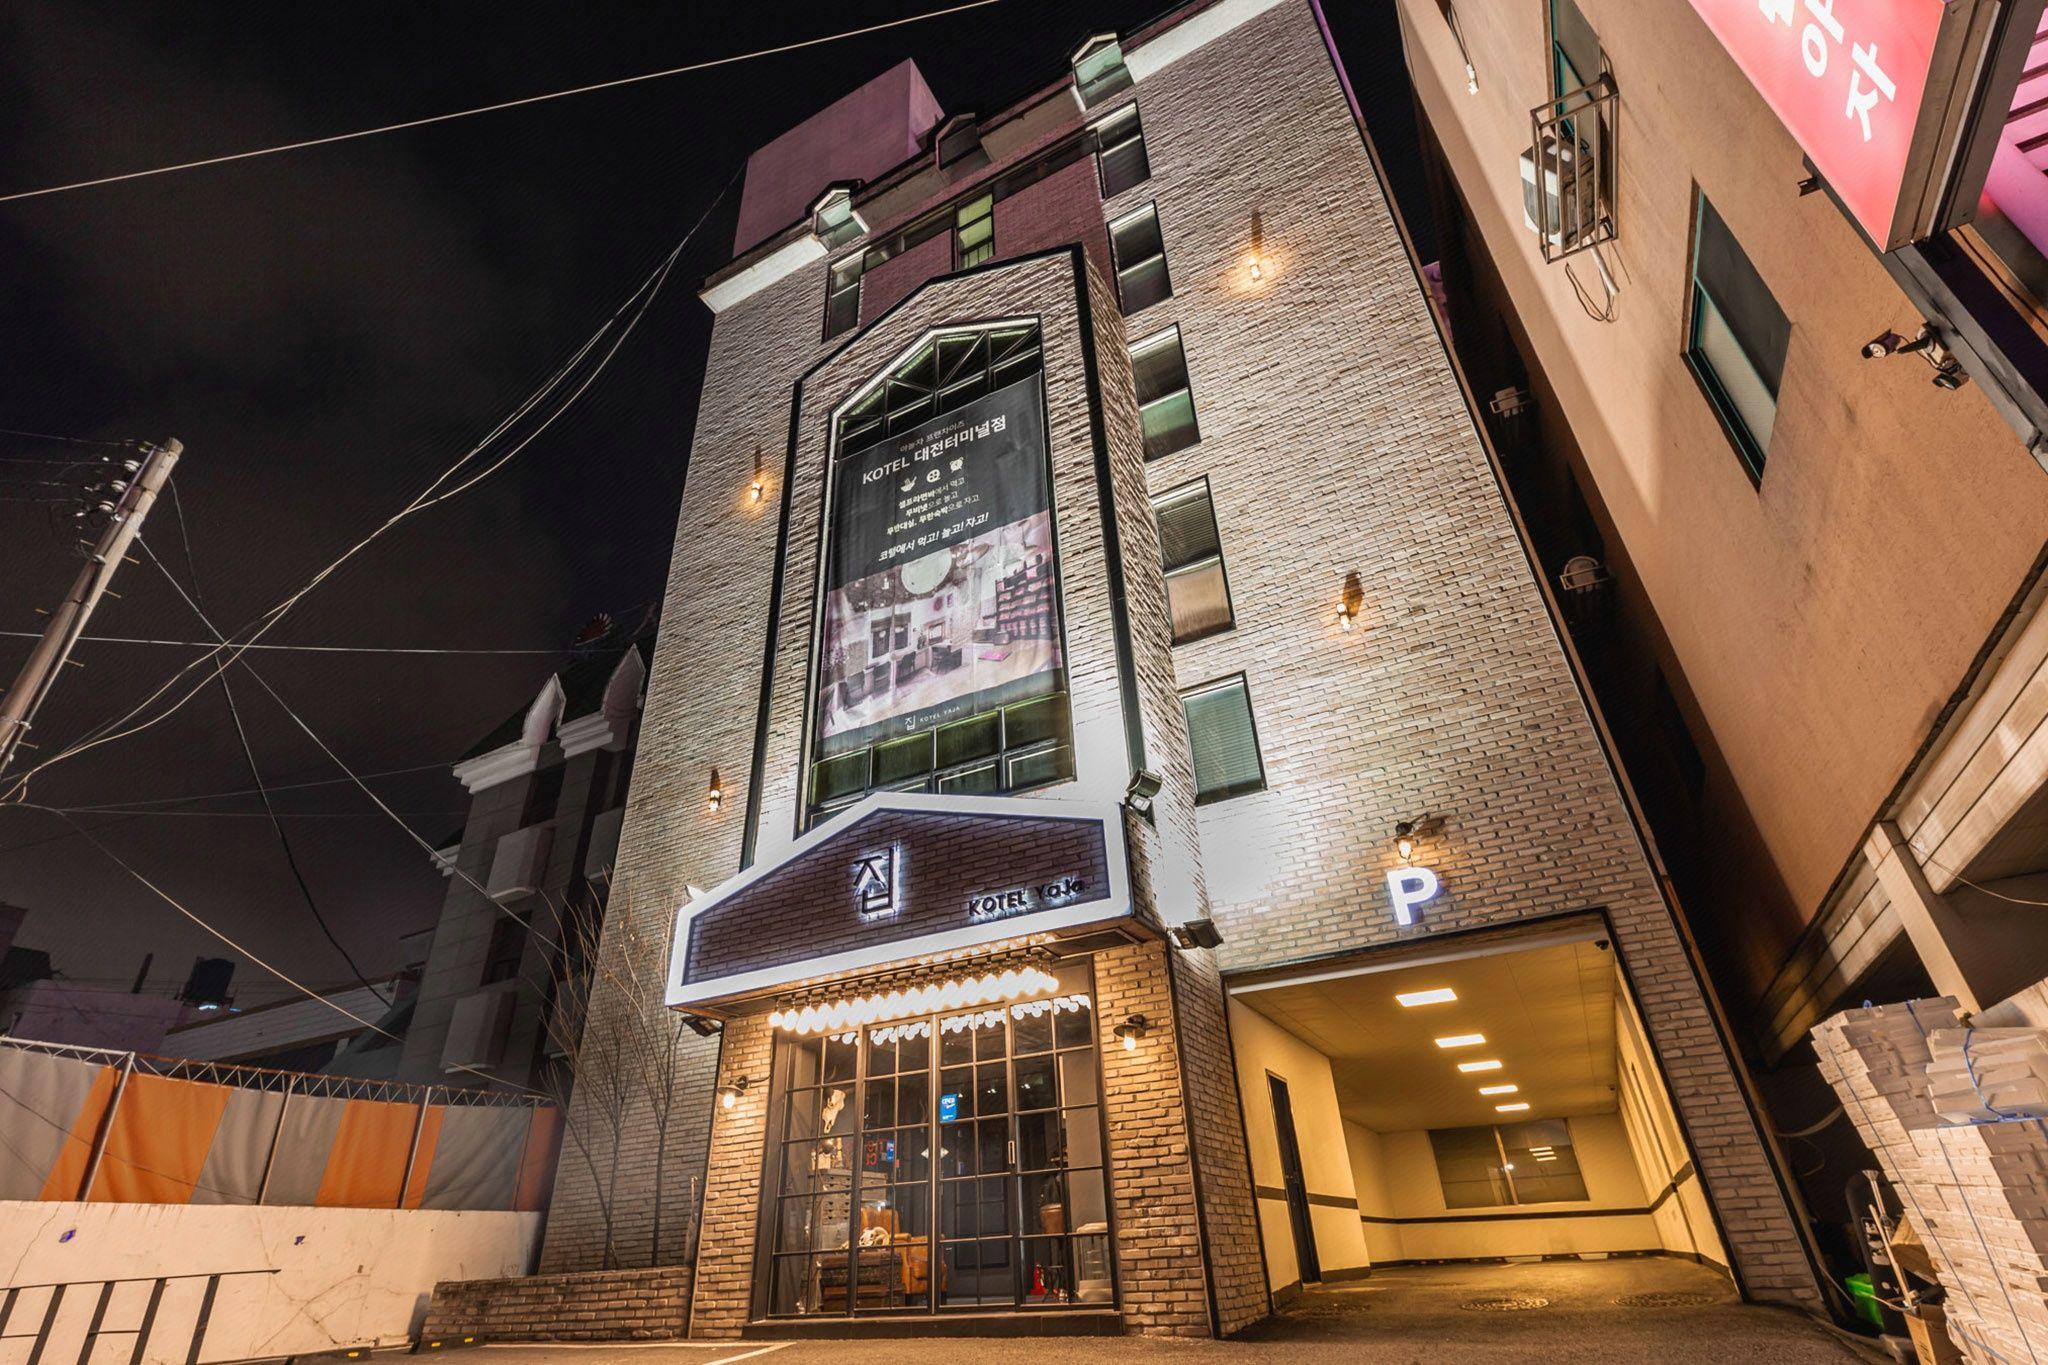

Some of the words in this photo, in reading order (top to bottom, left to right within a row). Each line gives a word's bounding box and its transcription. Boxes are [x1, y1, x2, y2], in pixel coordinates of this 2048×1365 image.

[926, 420, 966, 442] 프랜차이즈
[862, 456, 911, 485] KOTEL
[913, 414, 1007, 462] 대전터미널점
[950, 477, 965, 488] 먹고
[944, 490, 959, 502] 놀고
[963, 494, 981, 504] 자고
[878, 539, 915, 562] 코텔에서
[917, 530, 940, 546] 먹고!
[941, 521, 965, 539] 놀고!
[965, 511, 990, 528] 자고!
[919, 713, 941, 723] KOTEL
[943, 705, 961, 716] YAJA
[852, 846, 897, 915] 집
[968, 888, 1029, 917] KOTEL
[1387, 867, 1438, 926] P
